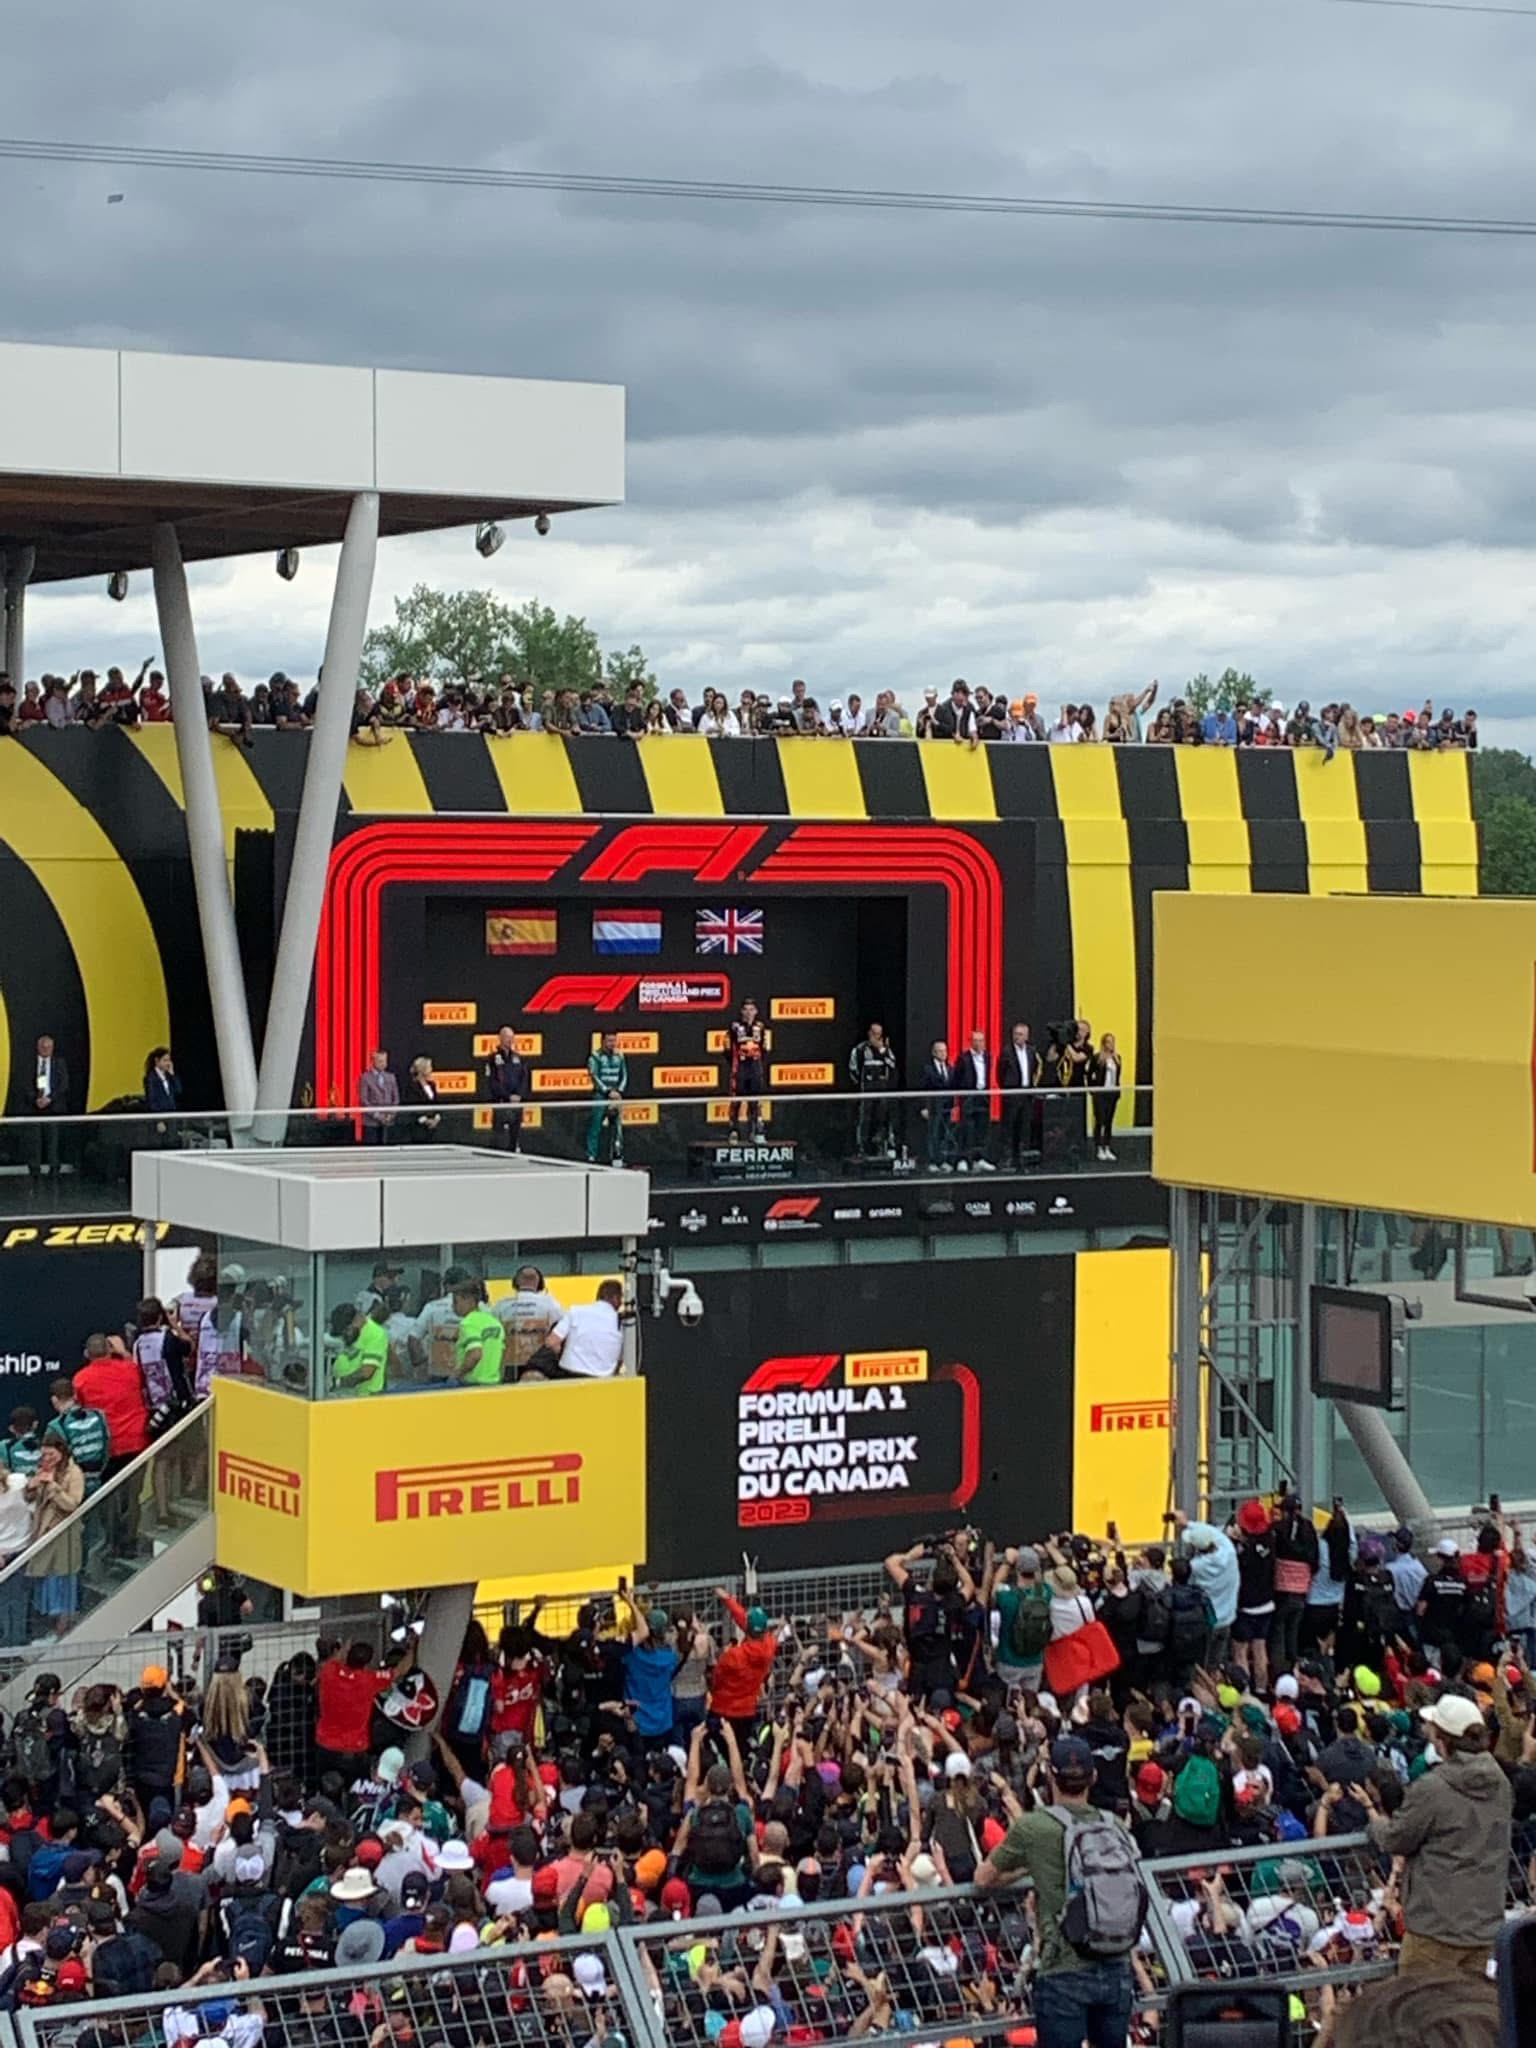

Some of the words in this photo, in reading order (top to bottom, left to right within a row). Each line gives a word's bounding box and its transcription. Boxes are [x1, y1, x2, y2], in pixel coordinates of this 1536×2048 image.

[778, 1002, 826, 1015] PIRELLI
[661, 1071, 710, 1084] PIRELLI
[778, 1068, 826, 1081] PIRELLI
[716, 1147, 793, 1162] FERRARI
[3, 1228, 38, 1247] P
[853, 1357, 919, 1378] PIRELLI
[738, 1387, 885, 1419] FORMULA
[889, 1386, 906, 1409] 1
[1091, 1400, 1177, 1432] PIREL
[738, 1415, 846, 1446] PIRELLI
[738, 1444, 845, 1472] GRAND
[848, 1436, 918, 1465] PRIX
[218, 1450, 301, 1517] PIRELLI
[374, 1453, 583, 1523] PIRELLI
[738, 1473, 781, 1499] DU
[784, 1464, 909, 1495] CANADA
[740, 1503, 808, 1523] 2023
